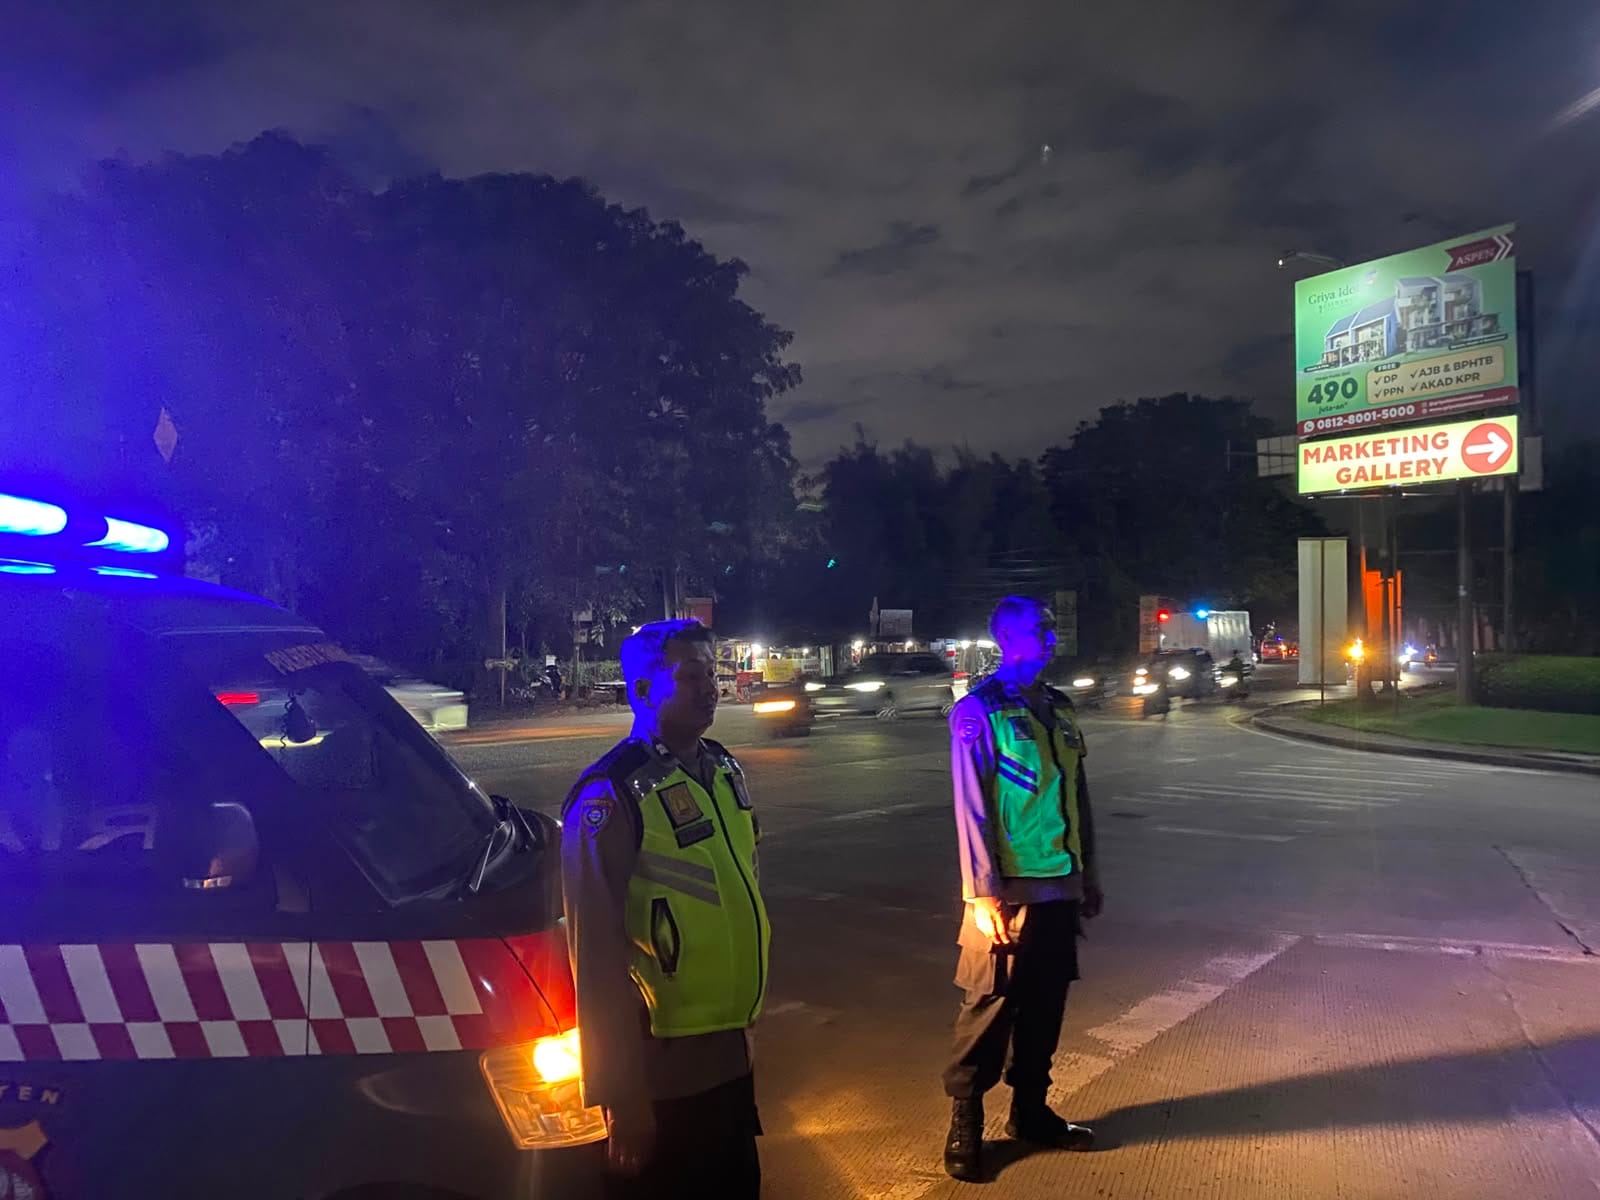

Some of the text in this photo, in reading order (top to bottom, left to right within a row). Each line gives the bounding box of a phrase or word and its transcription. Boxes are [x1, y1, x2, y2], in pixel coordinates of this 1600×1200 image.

[1308, 292, 1336, 304] Griya
[1377, 362, 1397, 371] FREE
[1418, 356, 1494, 377] AJB & BPHTB
[1383, 374, 1398, 384] DP
[1420, 372, 1481, 391] AKAD KPR
[1307, 377, 1359, 404] 490
[1383, 386, 1404, 397] PPN
[1317, 405, 1416, 430] 0812-8001-5000
[1303, 431, 1449, 465] MARKETING
[1336, 457, 1449, 485] GALLERY
